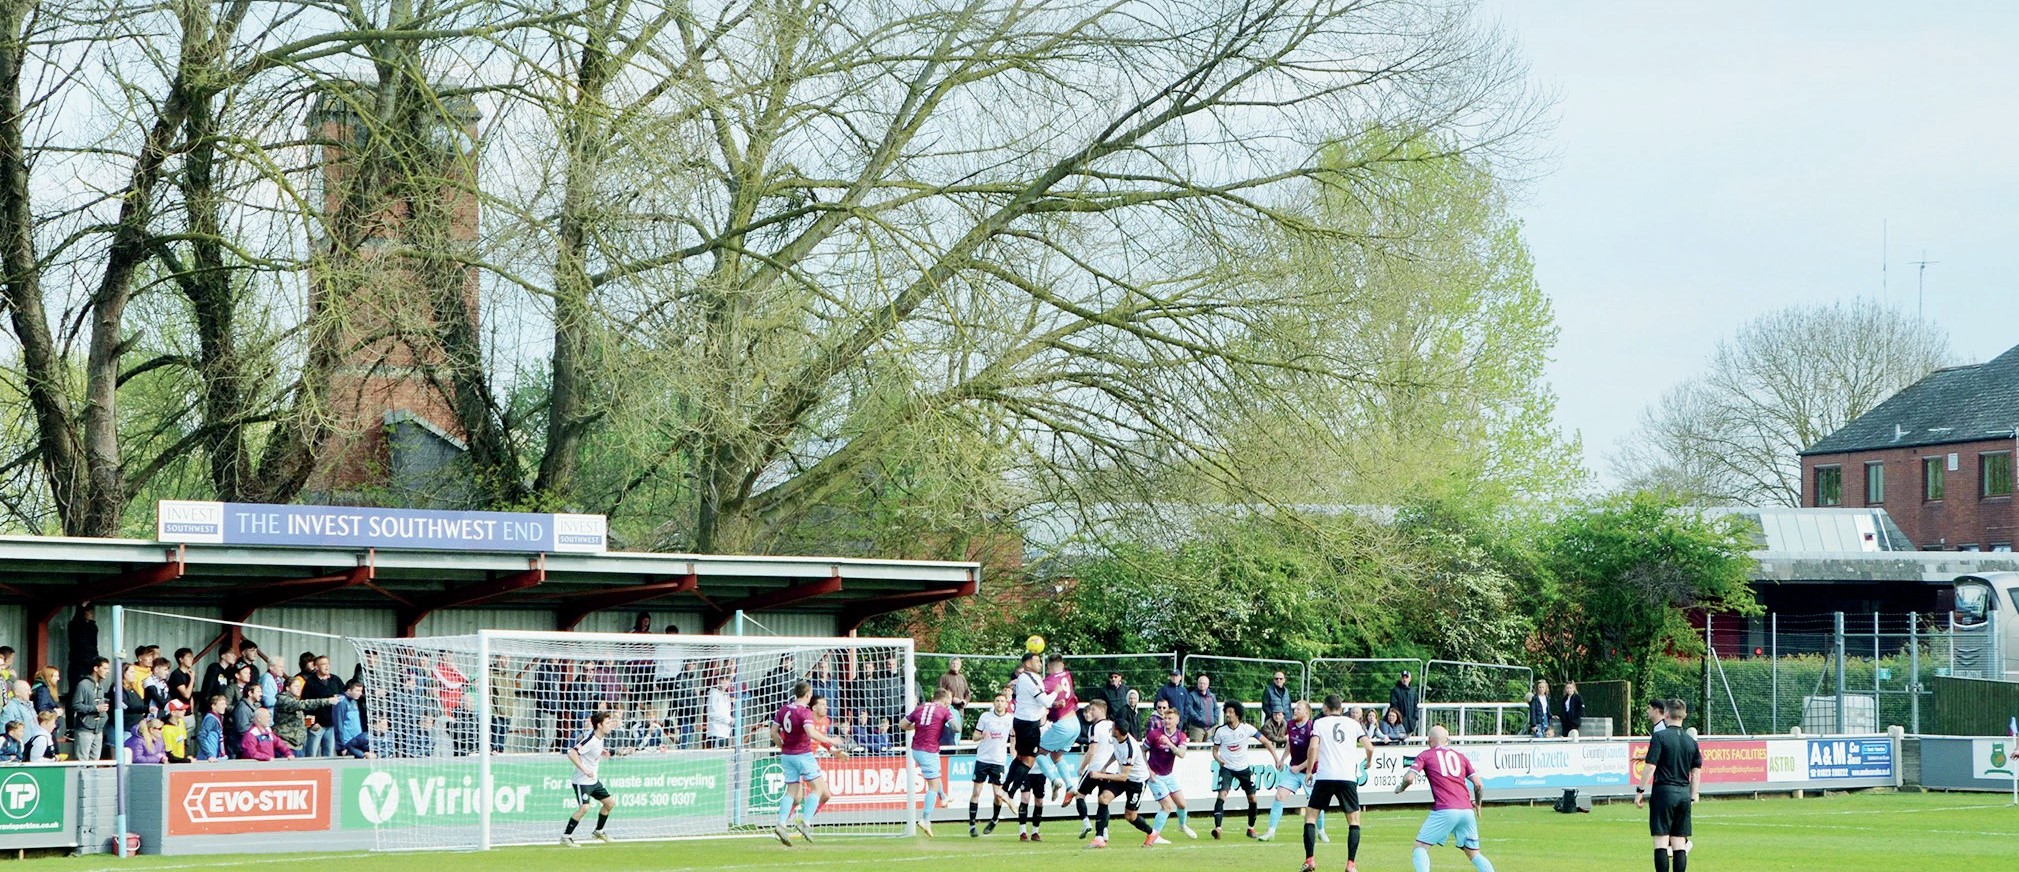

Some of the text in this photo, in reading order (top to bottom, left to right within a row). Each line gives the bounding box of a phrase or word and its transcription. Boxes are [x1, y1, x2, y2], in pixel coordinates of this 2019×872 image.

[167, 506, 215, 522] INVEST
[166, 524, 215, 534] SOUTHWEST
[235, 512, 543, 542] THE INVEST SOUTHWEST END
[560, 519, 600, 533] INVEST
[559, 535, 600, 545] SOUTHWEST
[1060, 677, 1071, 699] 9
[783, 710, 793, 734] 6
[920, 705, 935, 726] 11
[1332, 722, 1346, 744] 6
[1376, 753, 1398, 773] sky
[1436, 750, 1461, 777] 10
[1494, 746, 1569, 774] County Gazette
[1703, 748, 1767, 761] SPORTS FACILITIES
[1769, 756, 1795, 772] ASTRO
[1810, 741, 1847, 766] A&M
[543, 777, 562, 790] For
[609, 775, 642, 788] waste
[643, 774, 665, 788] and
[666, 773, 716, 790] recycling
[1374, 775, 1397, 786] 01823
[5, 783, 37, 810] TP
[209, 789, 309, 813] EVO-STIK
[408, 775, 532, 816] Viridor
[621, 793, 647, 807] 0345
[649, 793, 670, 806] 300
[671, 792, 697, 806] 0307
